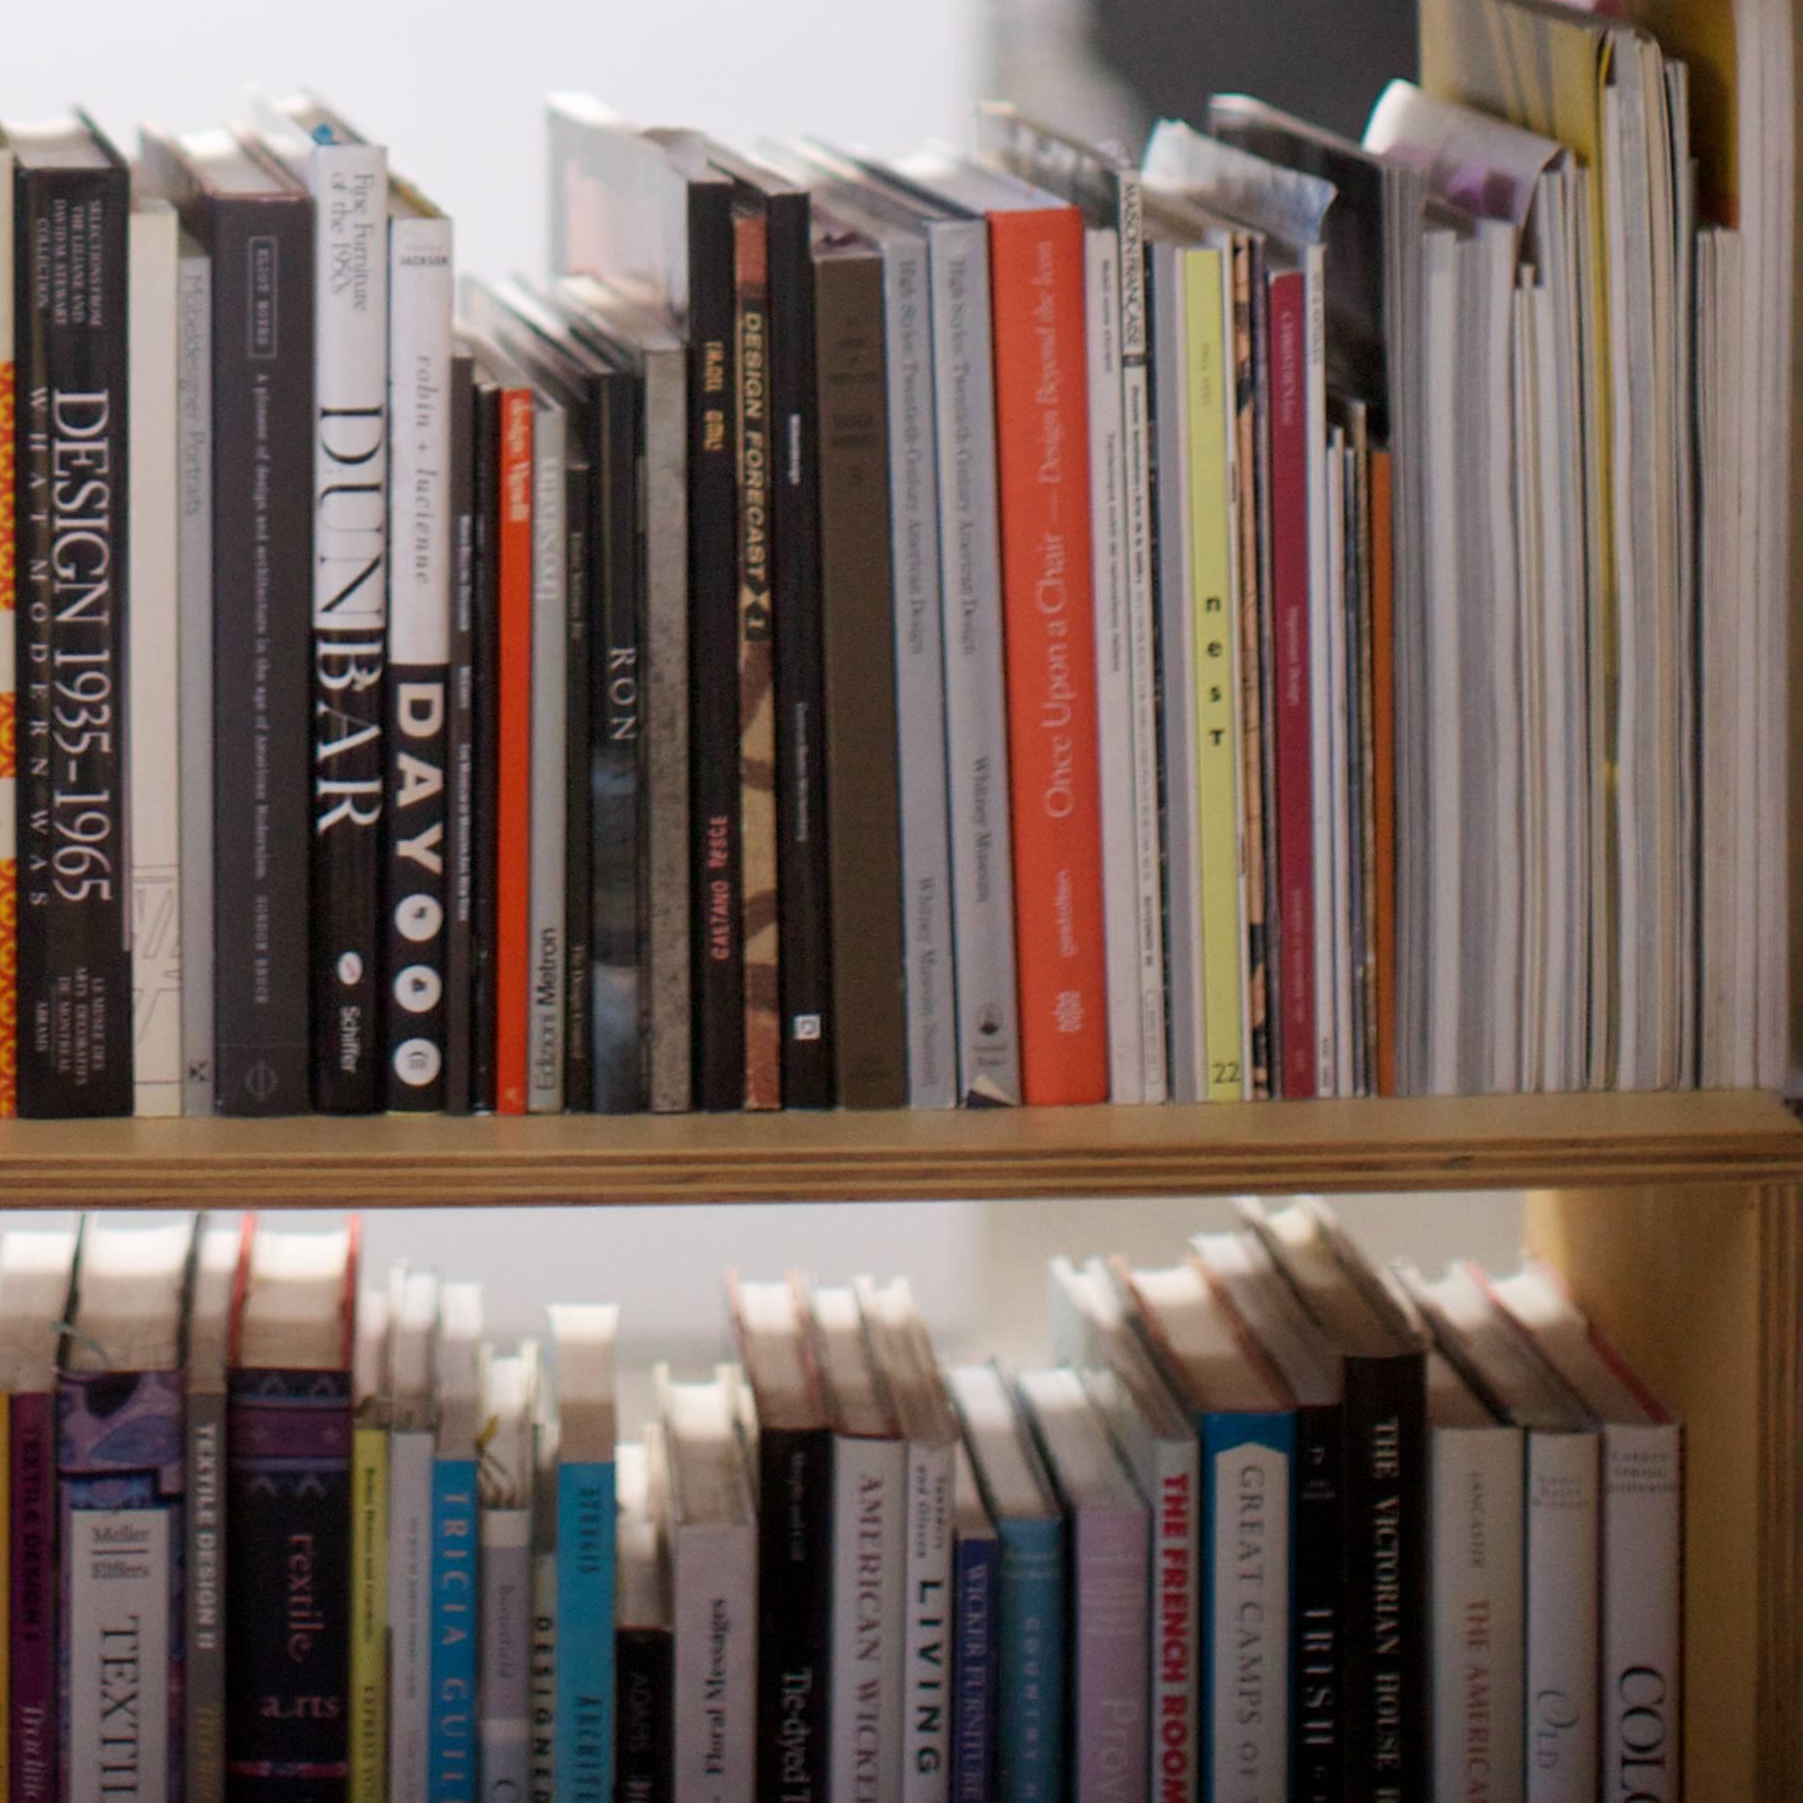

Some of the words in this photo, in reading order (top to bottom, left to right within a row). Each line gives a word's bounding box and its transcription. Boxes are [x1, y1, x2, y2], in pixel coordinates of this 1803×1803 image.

[331, 172, 353, 194] of
[331, 202, 353, 233] the
[352, 172, 374, 215] Fine
[351, 221, 373, 312] Furniture
[414, 355, 436, 428] robin
[744, 310, 763, 418] DESIGN
[28, 386, 48, 529] WHAT
[51, 387, 111, 626] DESIGN
[745, 430, 766, 583] FORECAST
[414, 468, 438, 585] lucienne
[29, 559, 49, 778] MODERN
[314, 403, 385, 835] DUNBAR
[607, 646, 638, 741] RON
[395, 682, 445, 876] DAY
[29, 809, 49, 907] WAS
[340, 1005, 361, 1073] Schiffer
[197, 1423, 217, 1526] TEXTILE
[1372, 1416, 1400, 1479] THE
[1163, 1472, 1189, 1539] THE
[1237, 1466, 1264, 1588] GREAT
[197, 1531, 217, 1626] DESIGN
[441, 1491, 467, 1646] TRICIA
[856, 1474, 882, 1662] AMERICAN
[1161, 1547, 1188, 1683] FRENCH
[1374, 1495, 1400, 1655] VICTORIAN
[197, 1632, 215, 1650] II
[704, 1599, 726, 1701] Messages
[916, 1579, 942, 1776] LIVING
[1237, 1602, 1263, 1724] CAMPS
[704, 1709, 724, 1776] Floral
[780, 1667, 814, 1783] Tie-dyed
[1375, 1673, 1399, 1769] HOUSE
